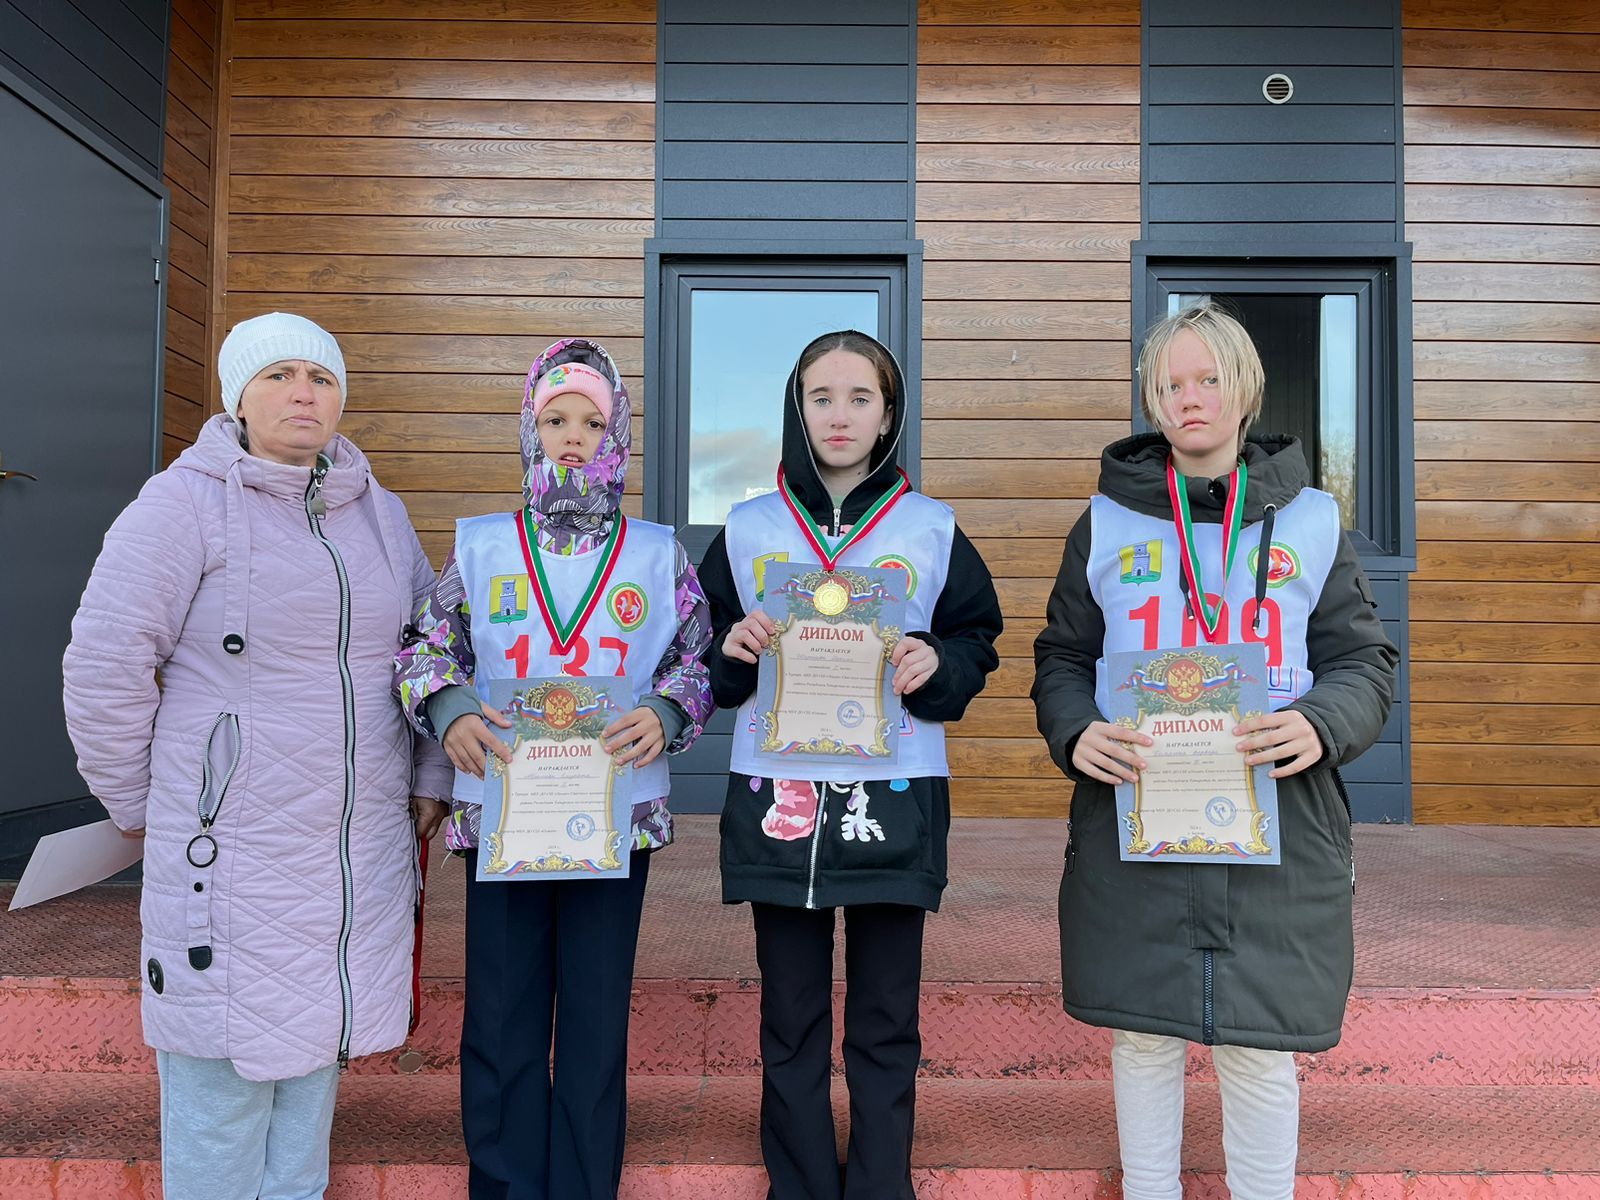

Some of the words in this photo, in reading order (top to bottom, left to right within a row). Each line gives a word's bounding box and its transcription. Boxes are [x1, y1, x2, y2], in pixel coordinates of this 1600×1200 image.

[799, 626, 865, 642] ДИПЛОМ
[1151, 718, 1225, 736] ДИПЛОМ
[526, 744, 593, 761] ДИПЛОМ
